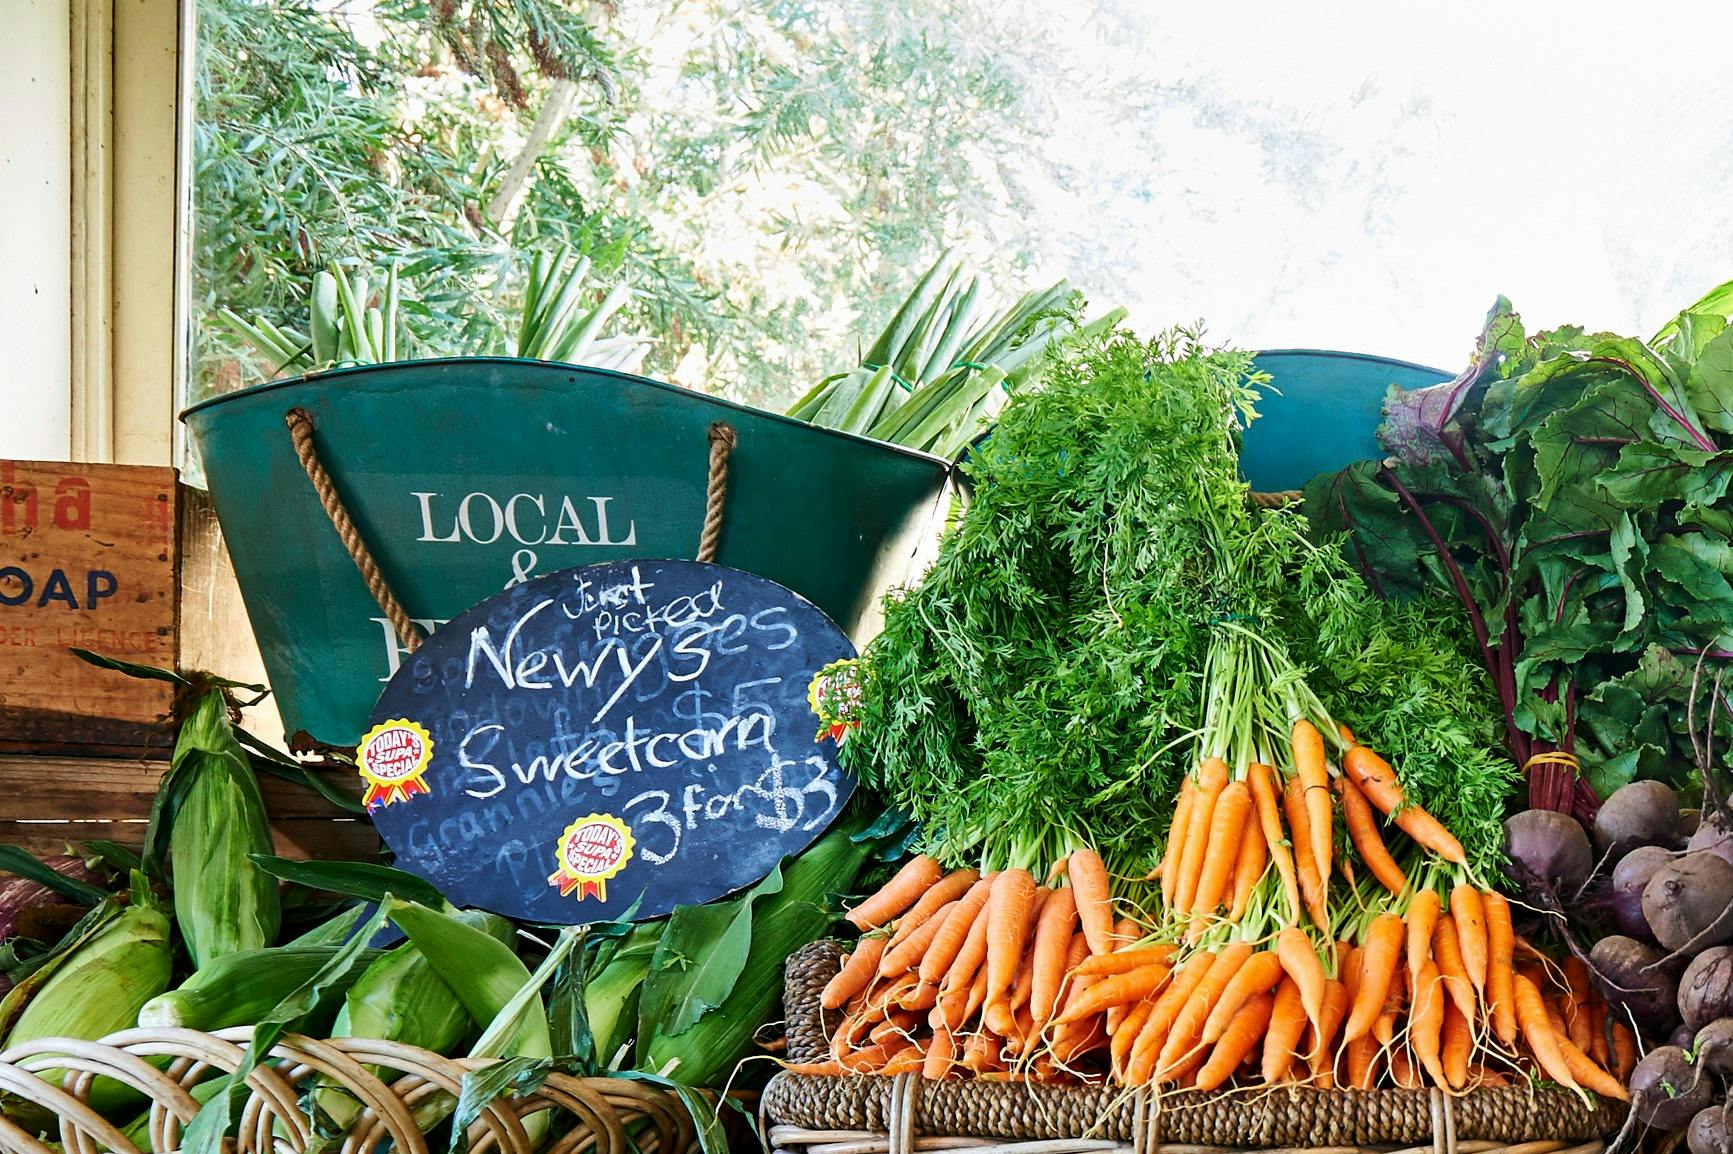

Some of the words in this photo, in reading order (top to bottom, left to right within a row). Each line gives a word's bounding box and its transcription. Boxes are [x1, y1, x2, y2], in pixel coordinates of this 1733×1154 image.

[411, 491, 636, 546] LOCAL
[0, 566, 118, 610] OAP
[593, 580, 725, 640] picked
[369, 730, 420, 756] TODAY'S
[374, 746, 413, 764] SUPA
[457, 713, 777, 799] Sweetcorn
[371, 757, 420, 777] SPECIAL
[622, 790, 682, 865] 3
[753, 751, 838, 833] $3
[574, 825, 623, 854] TODAY'S
[574, 842, 613, 859] SUPA
[568, 850, 612, 873] SPECIAL
